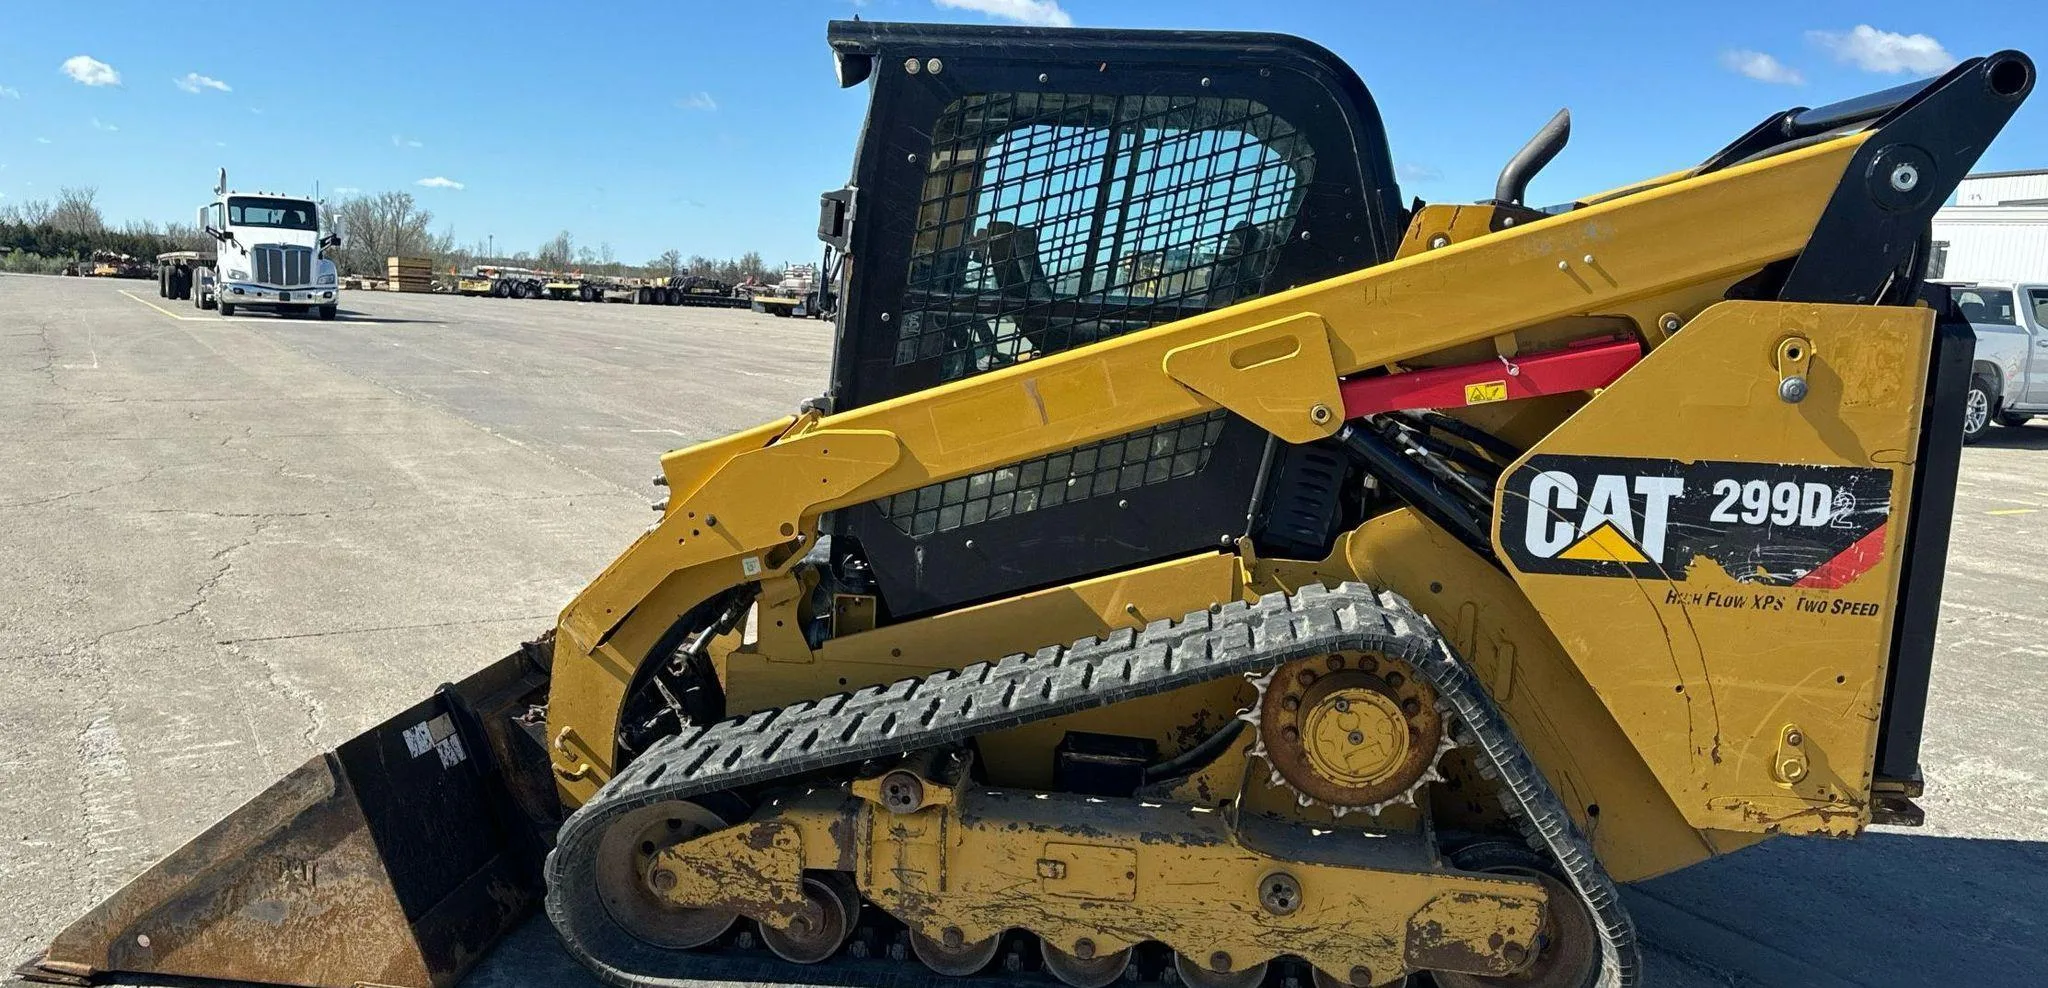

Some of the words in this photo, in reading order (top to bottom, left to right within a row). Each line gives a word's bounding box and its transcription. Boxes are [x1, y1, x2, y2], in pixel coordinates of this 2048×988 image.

[1525, 470, 1684, 564] CAT
[1751, 594, 1786, 611] XPS
[1796, 597, 1828, 613] TWO
[1830, 598, 1880, 617] SPEED
